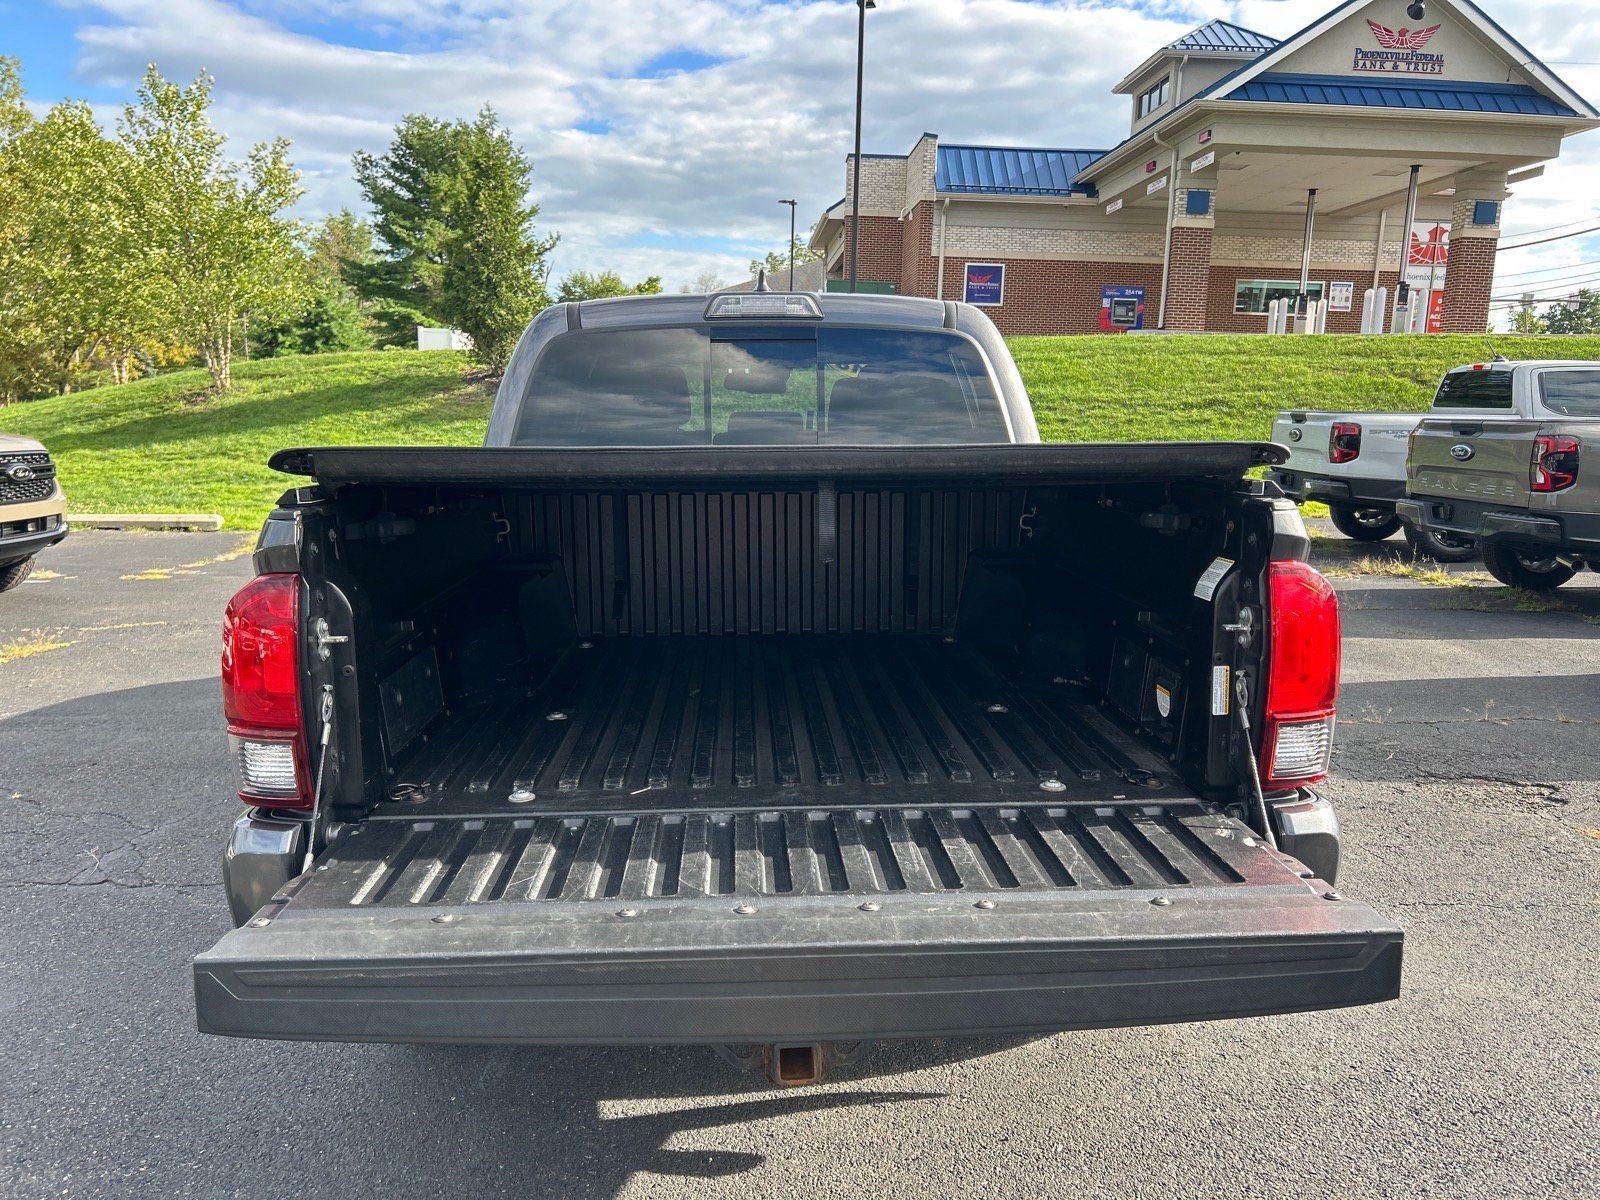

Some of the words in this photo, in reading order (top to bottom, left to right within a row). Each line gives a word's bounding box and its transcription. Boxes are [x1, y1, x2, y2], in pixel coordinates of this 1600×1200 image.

[1353, 60, 1387, 70] BANK
[1391, 62, 1400, 71] &
[1406, 62, 1444, 73] TRUST
[1406, 272, 1431, 281] hoenix
